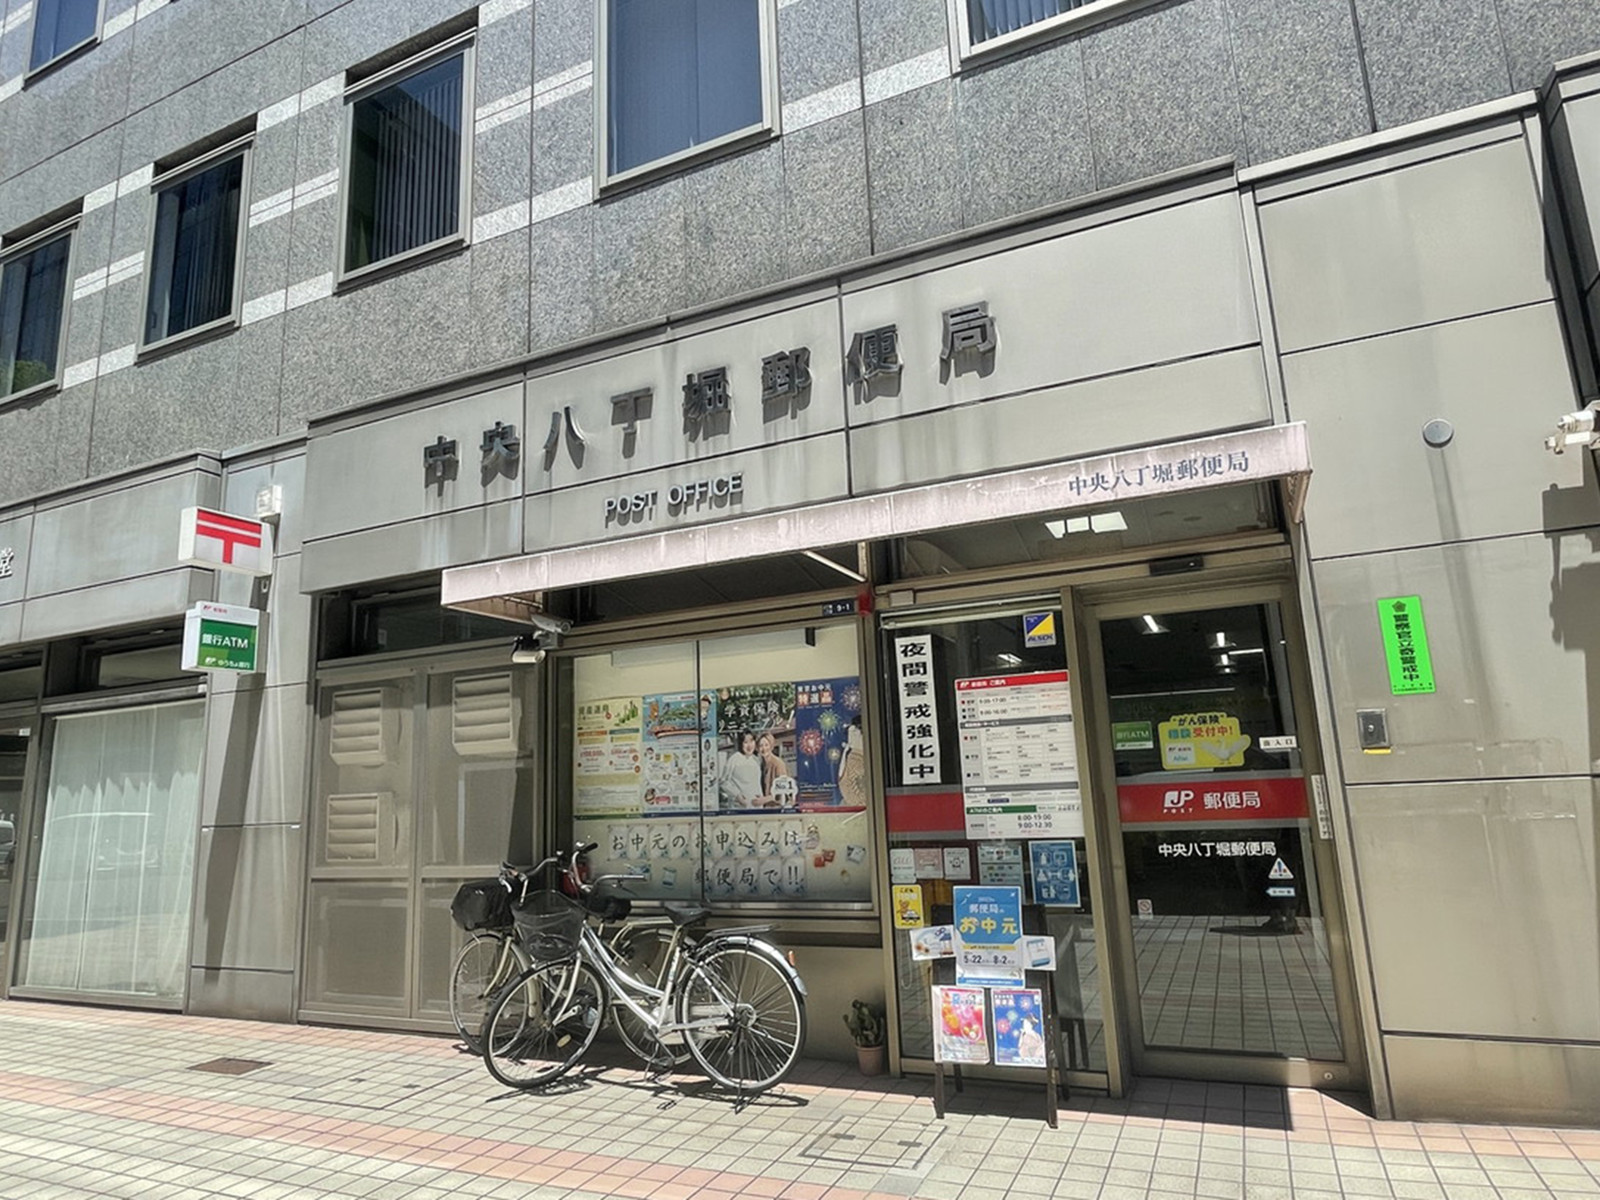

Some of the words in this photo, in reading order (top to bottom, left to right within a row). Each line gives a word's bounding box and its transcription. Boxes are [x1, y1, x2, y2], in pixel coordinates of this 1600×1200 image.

[423, 301, 994, 490] 中央八丁堀郵便局
[1068, 450, 1250, 497] 中央八丁堀郵便局
[604, 490, 658, 517] POST
[667, 472, 743, 505] OFFICE
[201, 633, 249, 649] 銀行ATM
[900, 642, 935, 779] 夜間警戒強化中
[1203, 790, 1261, 810] 郵便局
[1158, 841, 1277, 858] 中央八丁堀郵便局
[959, 916, 1019, 935] お中元
